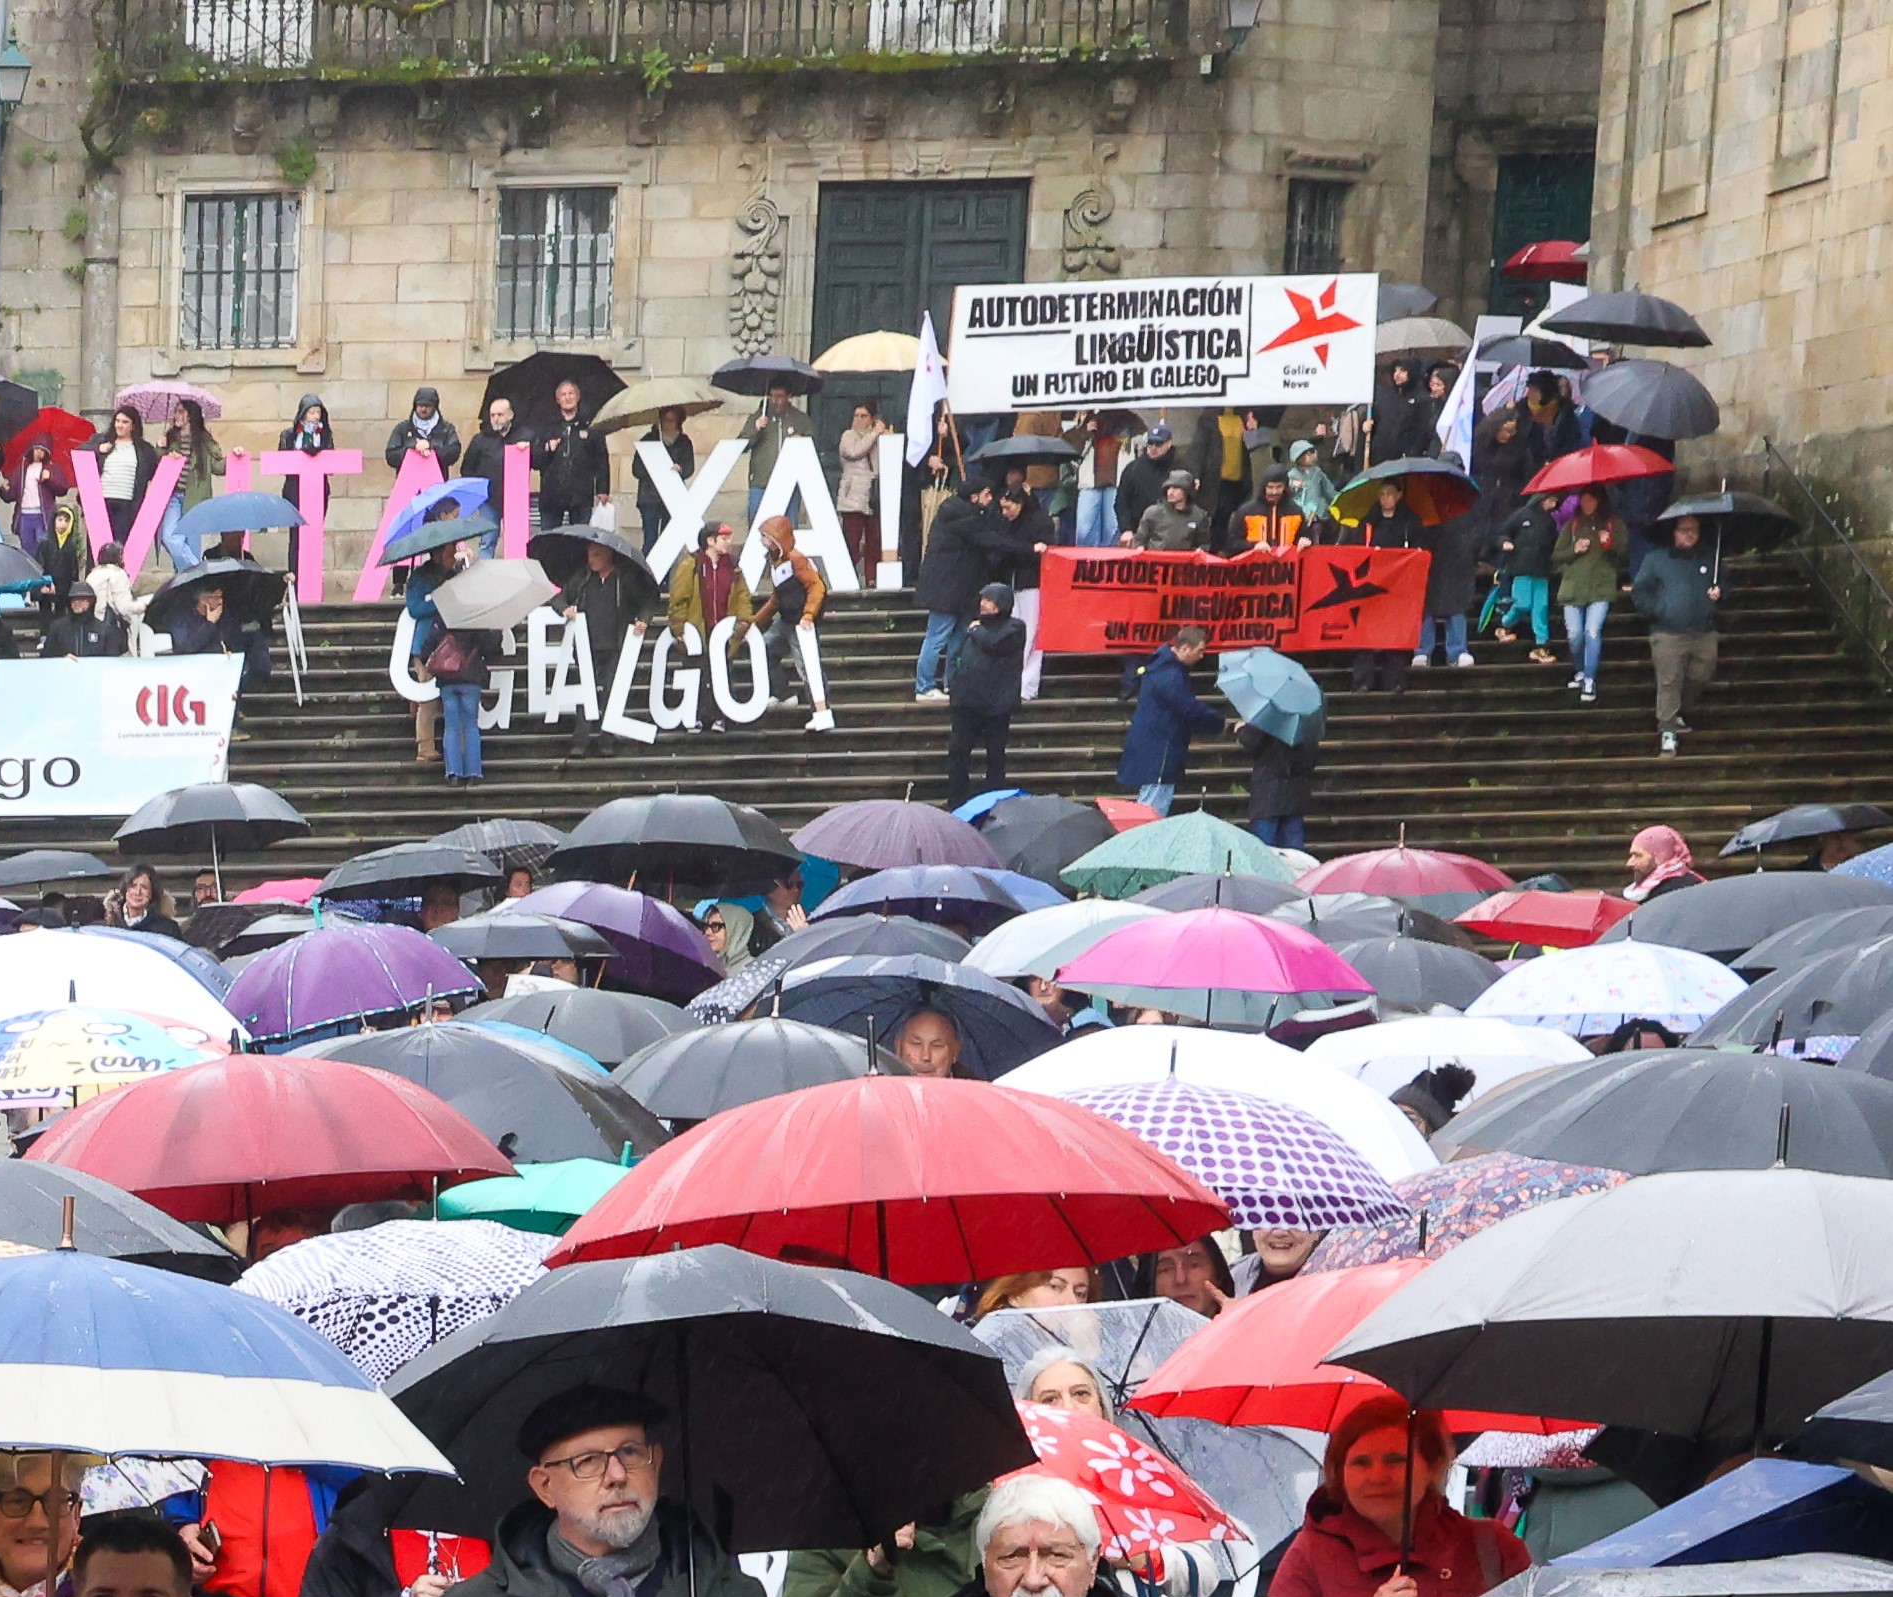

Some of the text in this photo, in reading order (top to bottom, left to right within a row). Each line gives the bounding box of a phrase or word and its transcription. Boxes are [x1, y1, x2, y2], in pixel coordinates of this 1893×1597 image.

[968, 281, 1244, 329] AUTODETERMINACIÓN
[1074, 323, 1243, 366] LINGÜÍSTICA
[1011, 364, 1221, 398] UN FUTURO EN GALEGO
[135, 684, 207, 727] CIG
